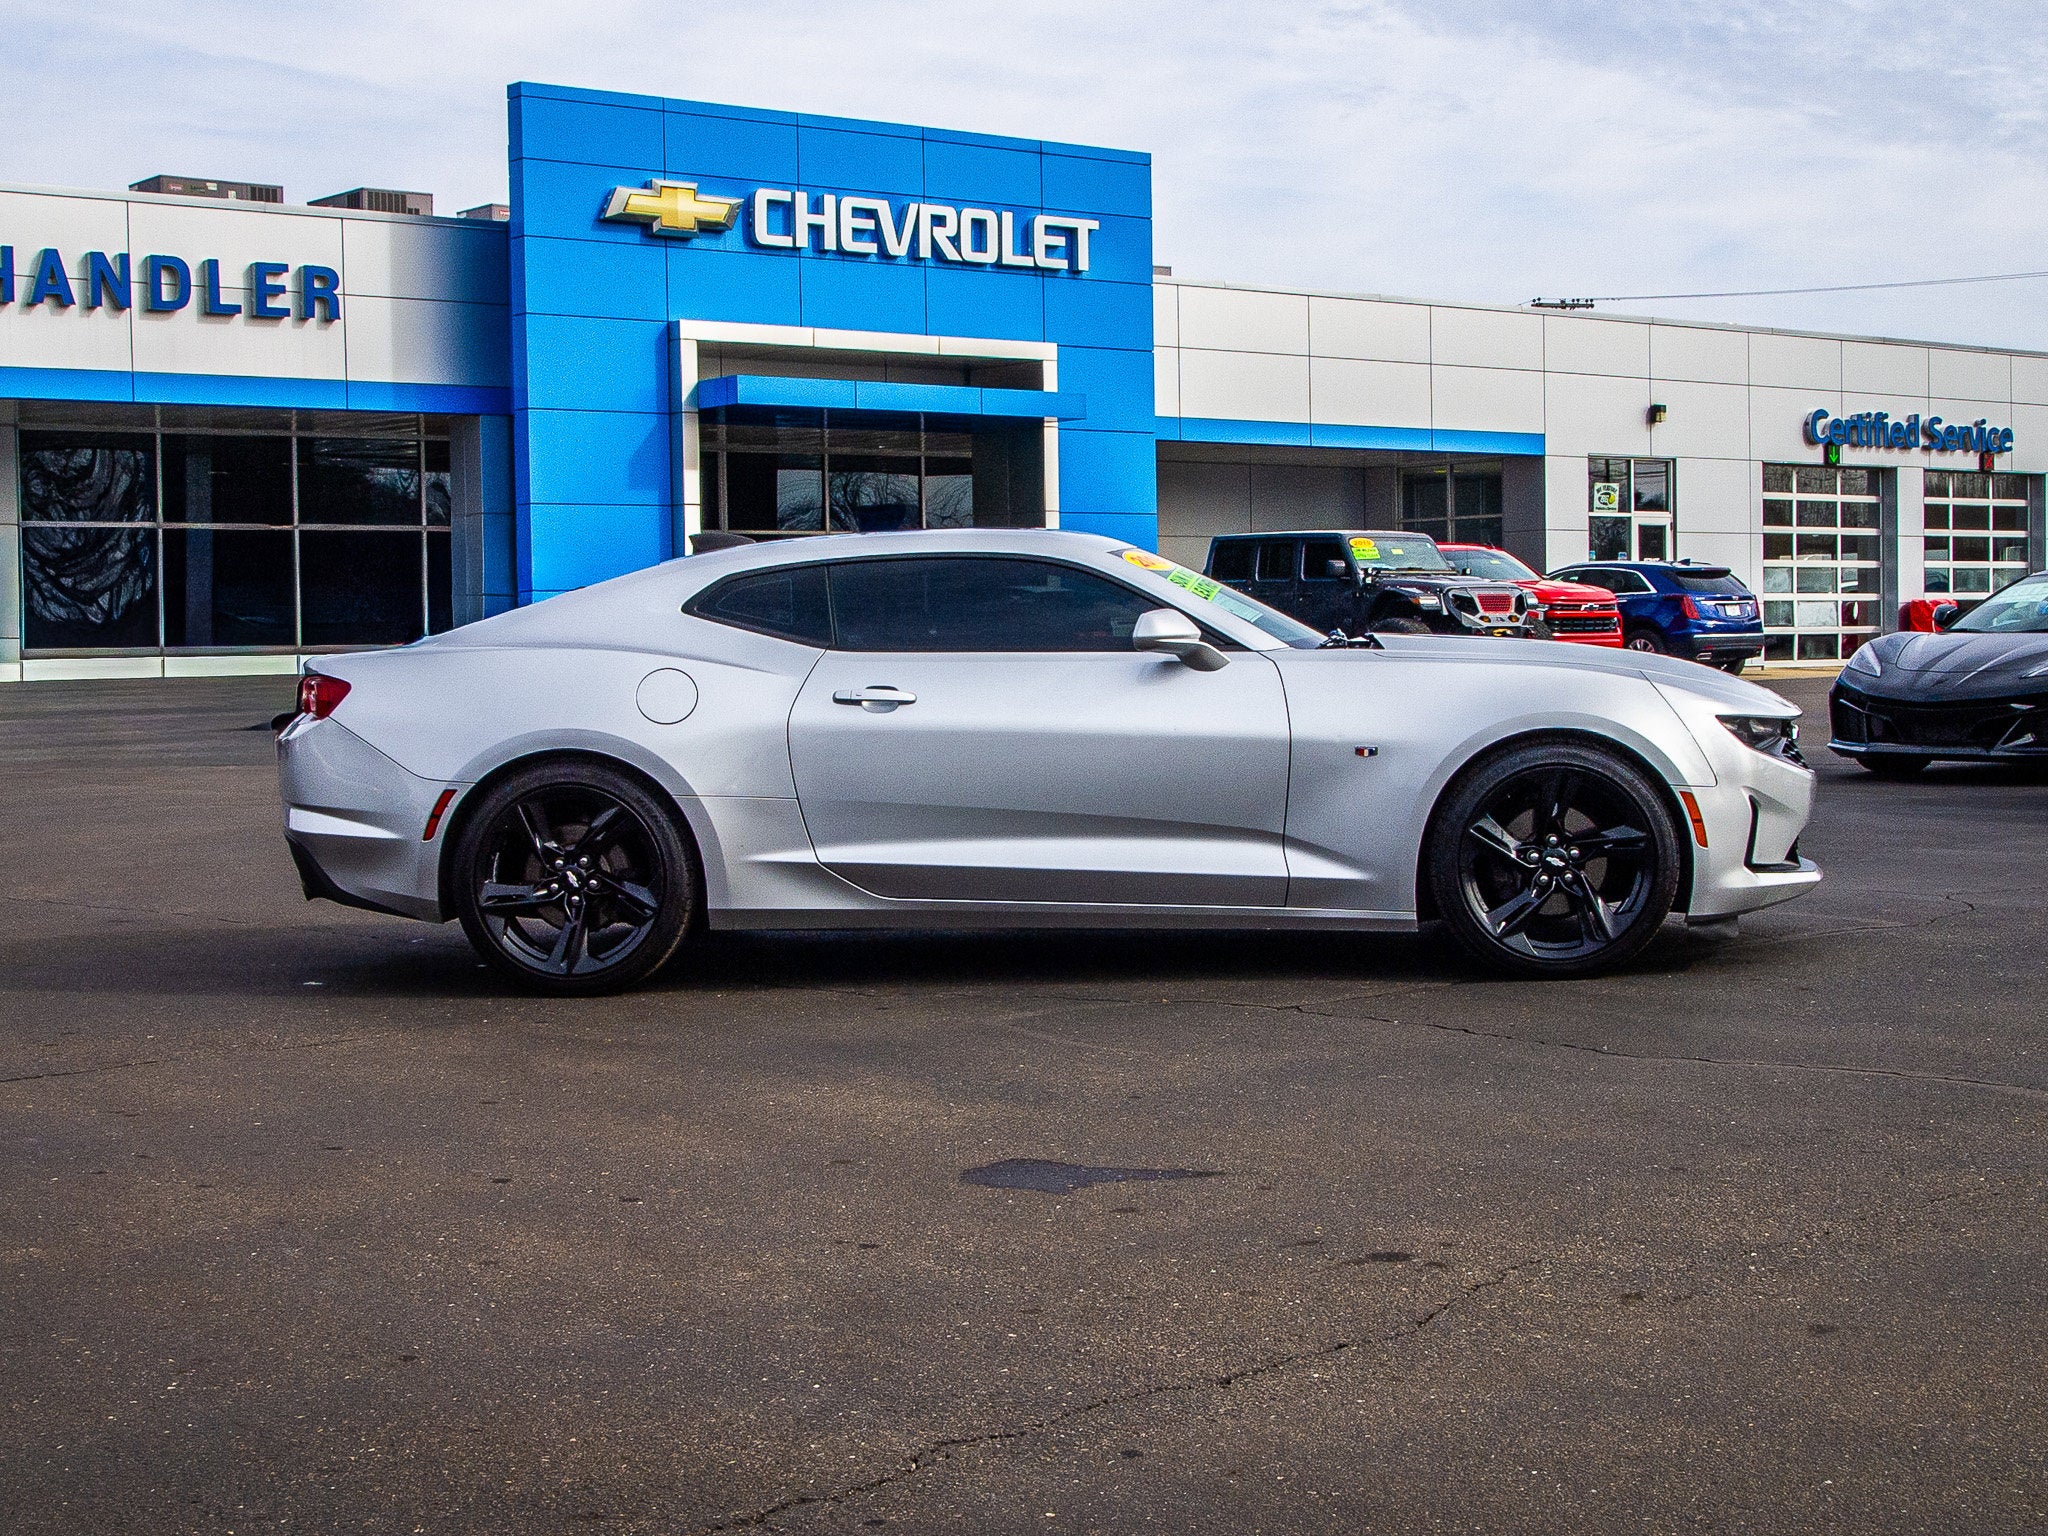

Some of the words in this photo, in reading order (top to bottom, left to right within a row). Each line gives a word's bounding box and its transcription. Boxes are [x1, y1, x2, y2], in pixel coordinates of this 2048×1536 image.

[754, 188, 1100, 272] CHEVROLET
[1807, 408, 1921, 448] Certified
[1926, 416, 2015, 453] Service
